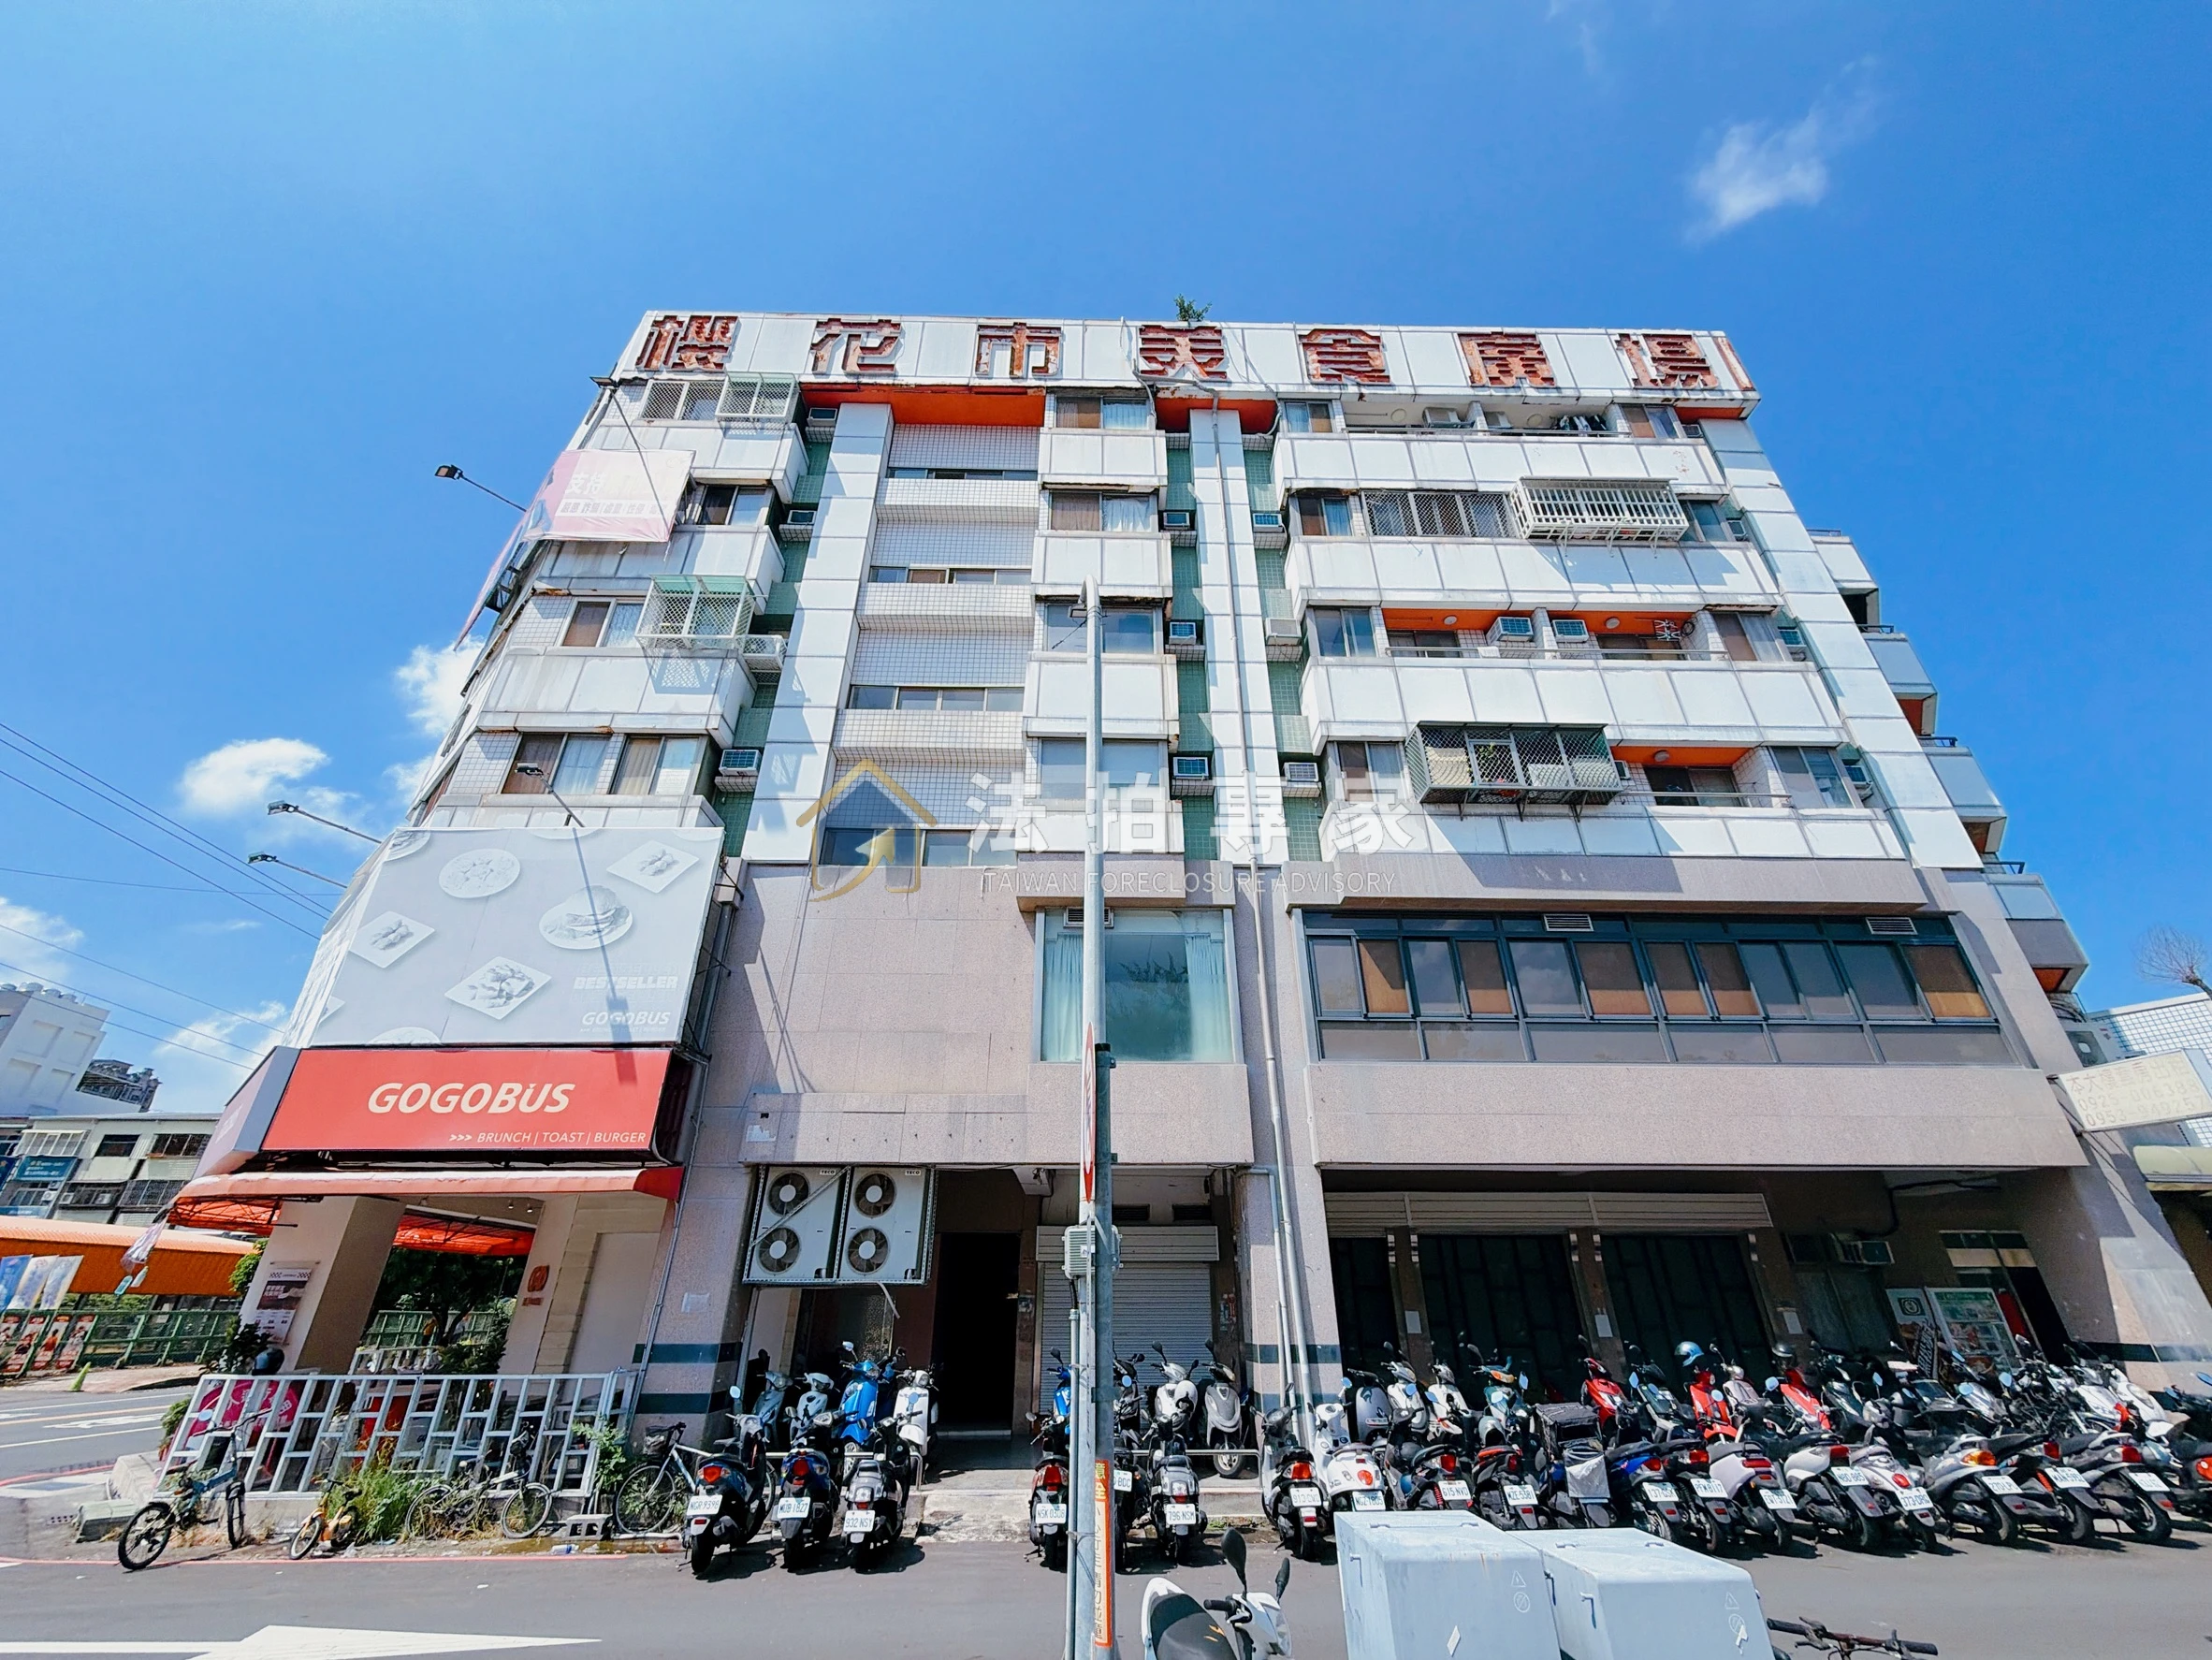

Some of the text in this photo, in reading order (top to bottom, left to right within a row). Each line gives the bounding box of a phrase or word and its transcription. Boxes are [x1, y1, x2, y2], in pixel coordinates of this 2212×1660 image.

[573, 976, 678, 989] BESTSELLER
[581, 1011, 672, 1026] GOGOBUS
[369, 1082, 575, 1114] GOGOBUS
[477, 1131, 647, 1144] BRUNCH TOAST BURGER
